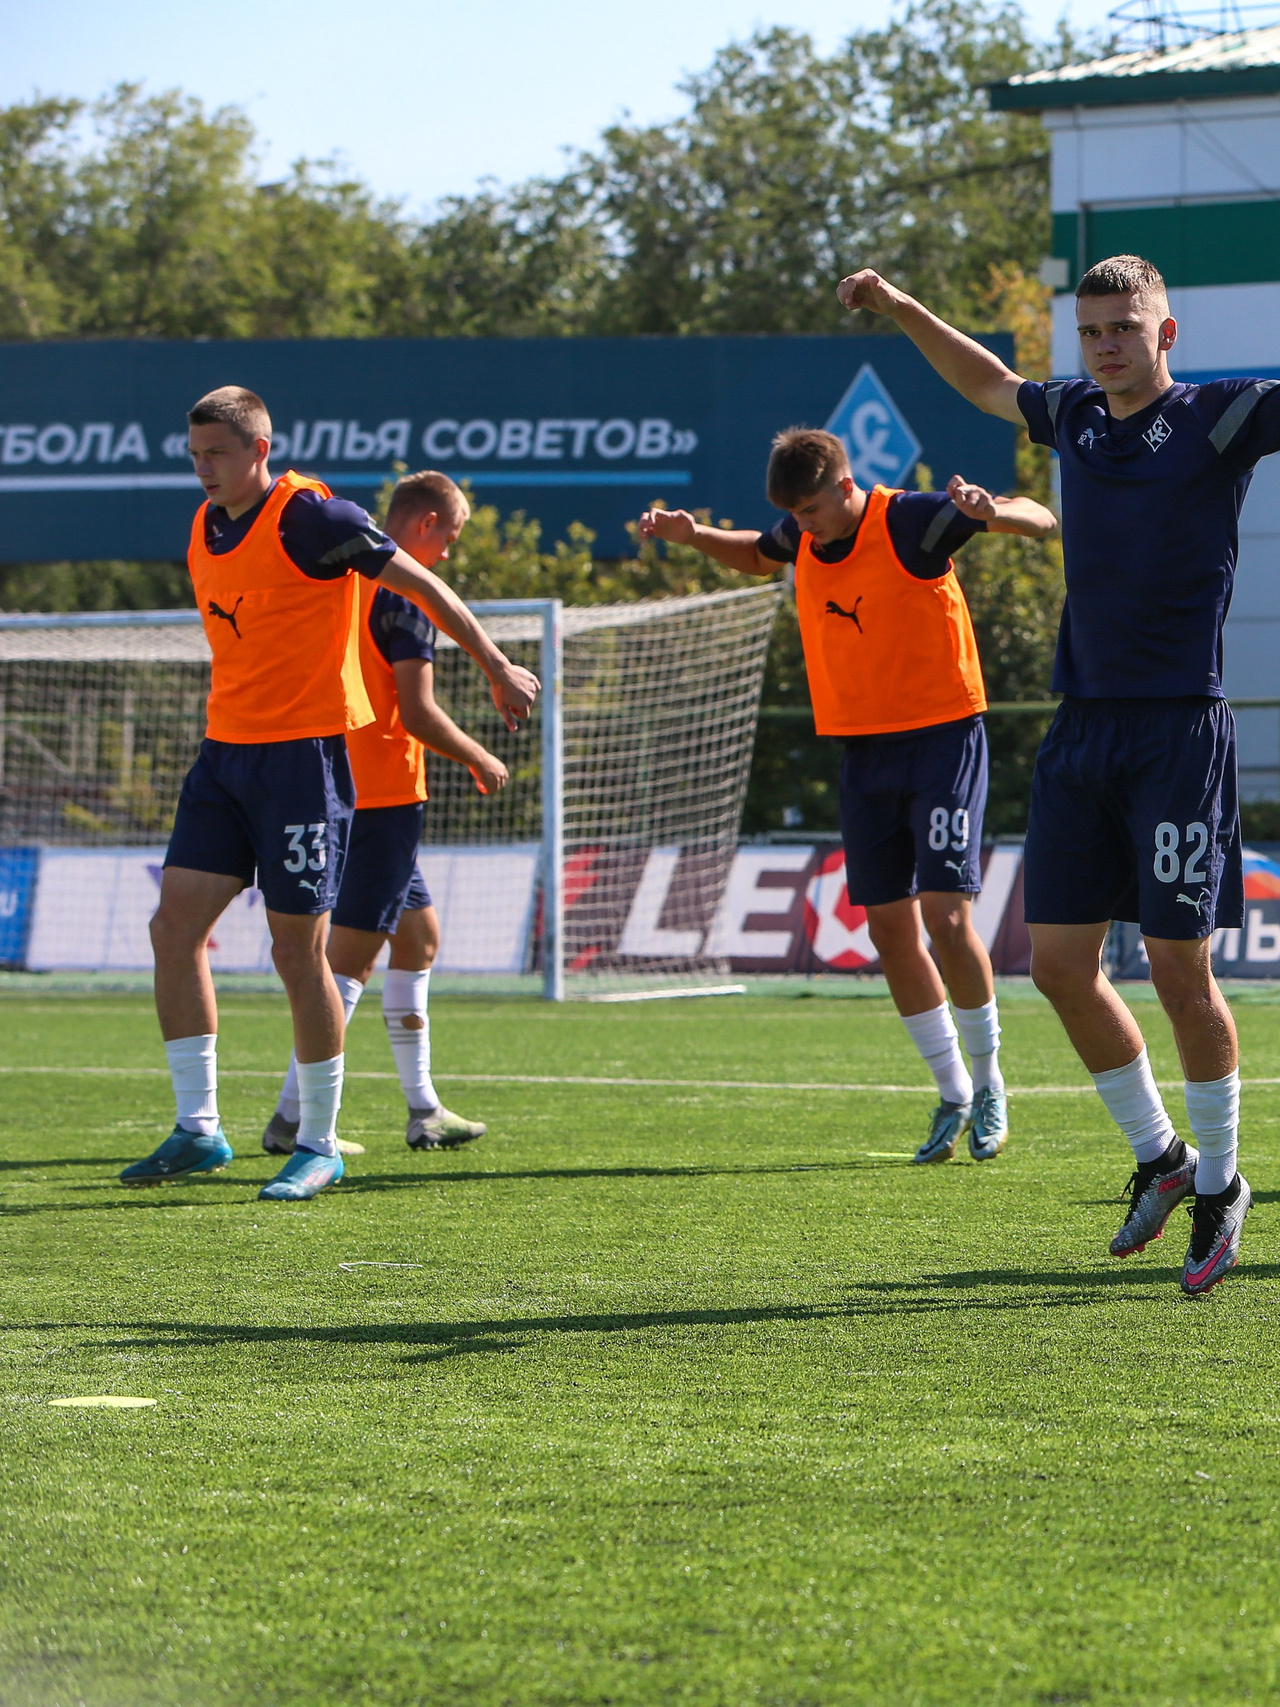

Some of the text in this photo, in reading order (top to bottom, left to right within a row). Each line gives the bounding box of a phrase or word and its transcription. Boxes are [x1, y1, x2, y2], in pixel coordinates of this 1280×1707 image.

[0, 417, 698, 465] БОЛА «ЫЛЬЯ СОВЕТОВ»
[283, 822, 327, 874] 33
[928, 806, 970, 852] 89
[1153, 821, 1209, 884] 82
